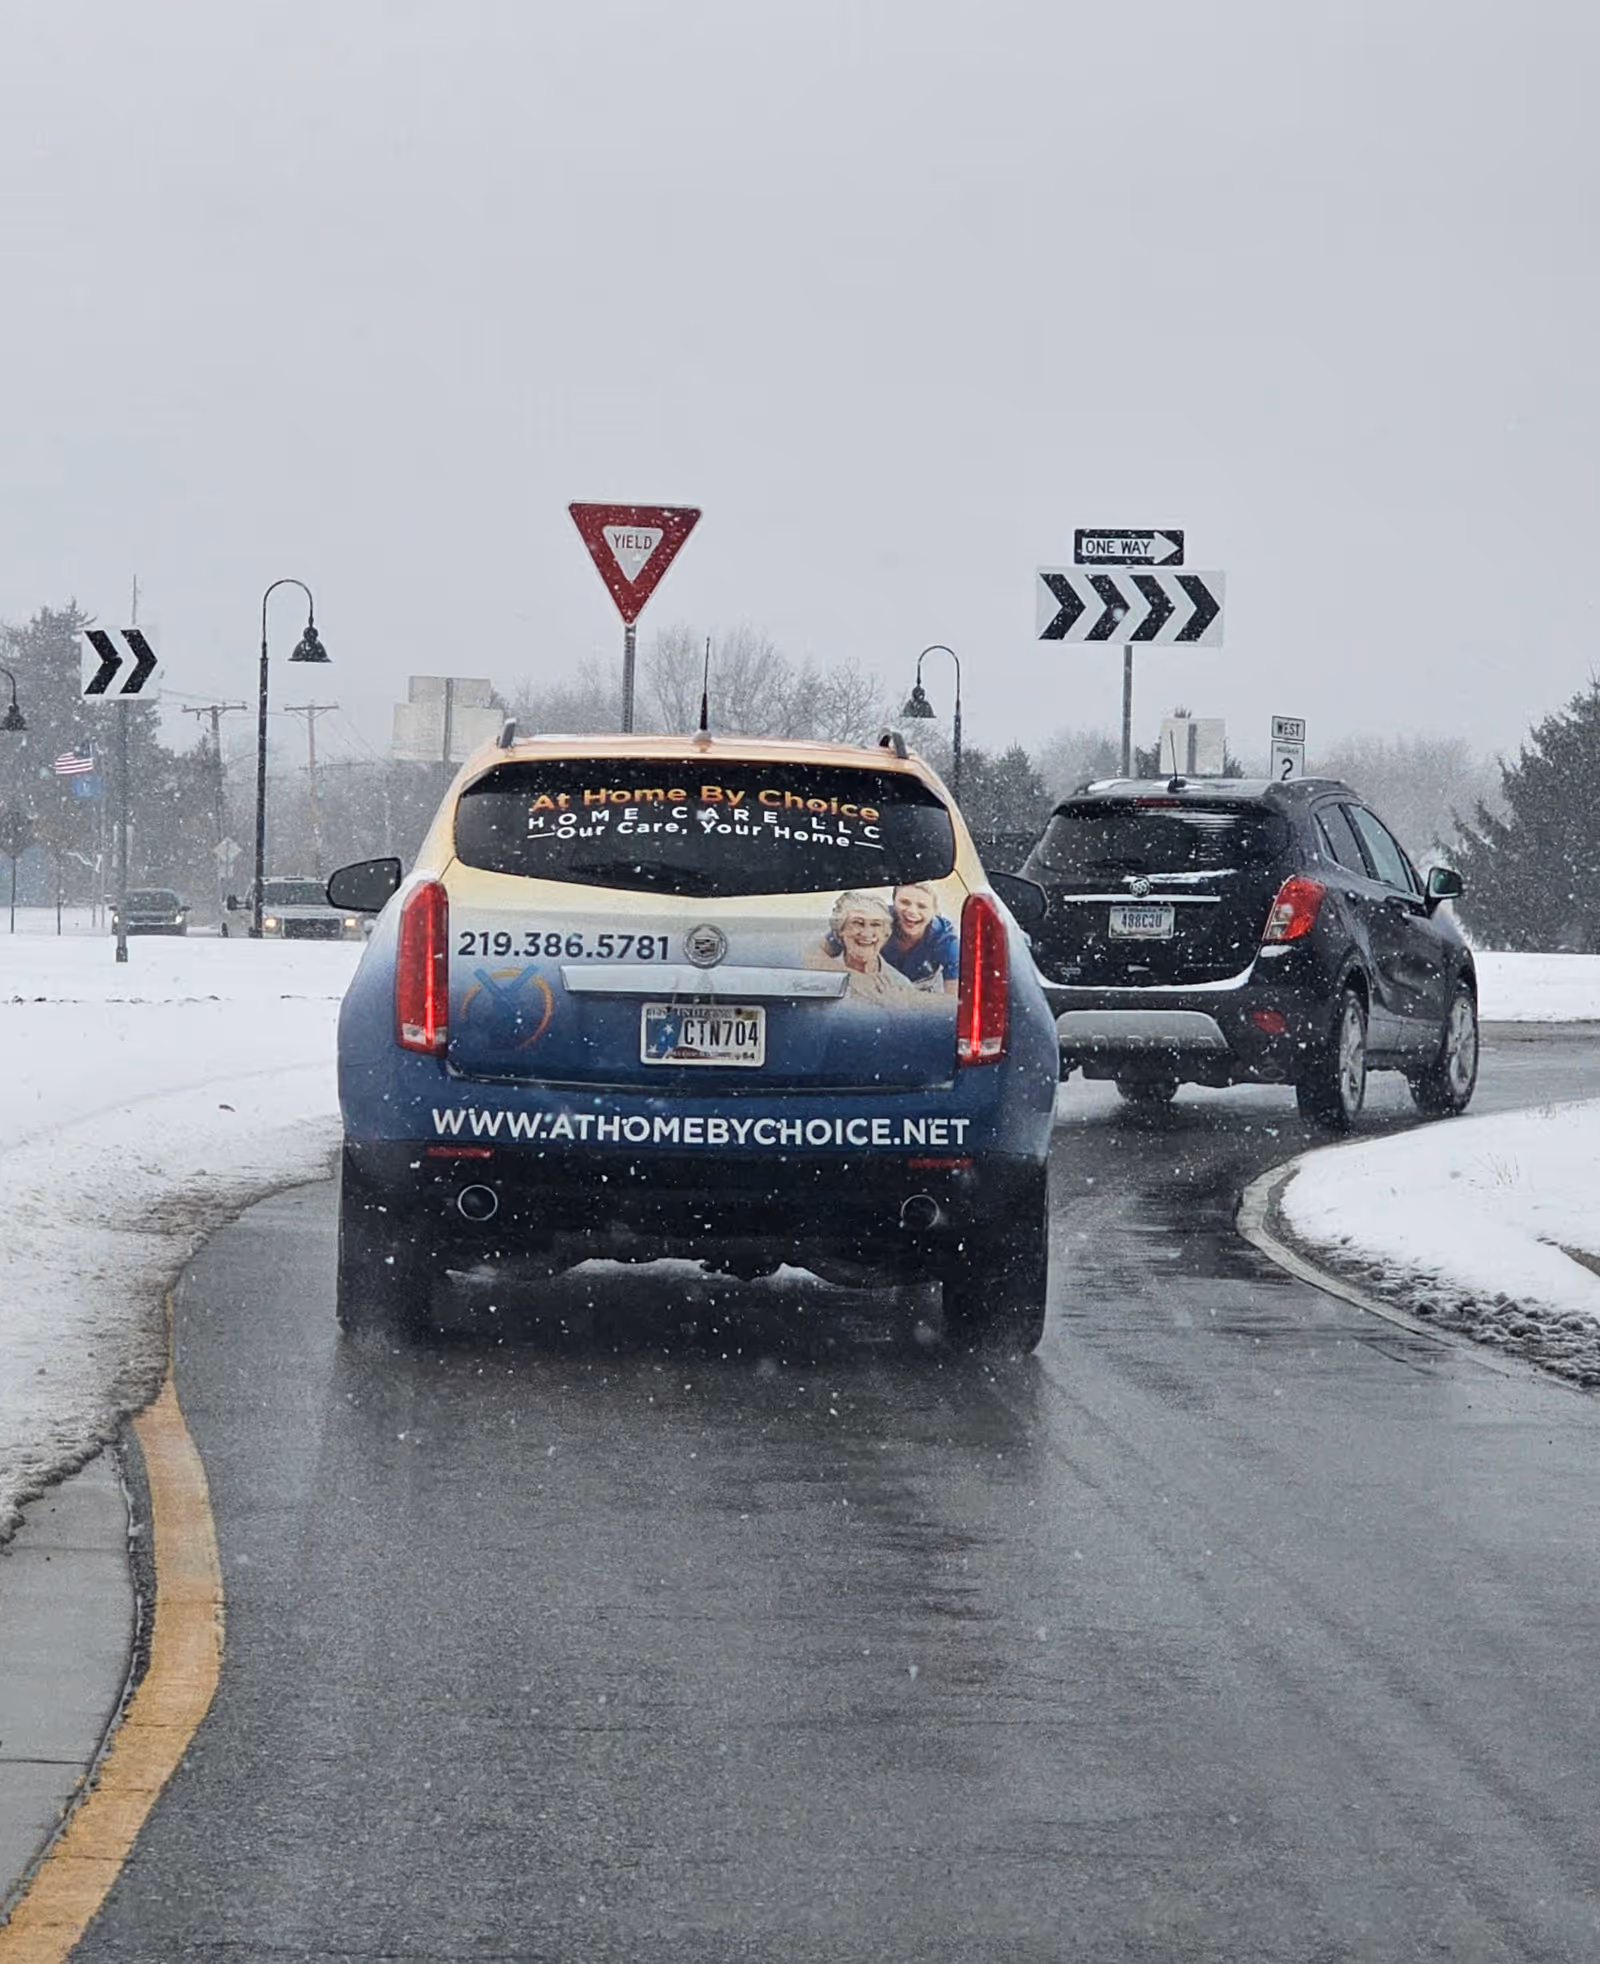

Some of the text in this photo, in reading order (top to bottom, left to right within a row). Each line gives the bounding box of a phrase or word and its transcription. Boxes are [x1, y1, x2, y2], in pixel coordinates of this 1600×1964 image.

[613, 533, 653, 550] YIELD
[1085, 539, 1151, 555] ONE WAY
[1277, 721, 1300, 736] WEST
[1281, 758, 1293, 780] 2
[530, 785, 880, 821] At Home By Choice
[528, 806, 881, 839] HOME CARE LLC
[556, 820, 850, 848] Our Care, Your Home
[458, 931, 669, 961] 219.386.5781
[684, 1019, 759, 1047] CTN704
[432, 1108, 970, 1145] WWW.ATHOMEBYCHOICE.NET
